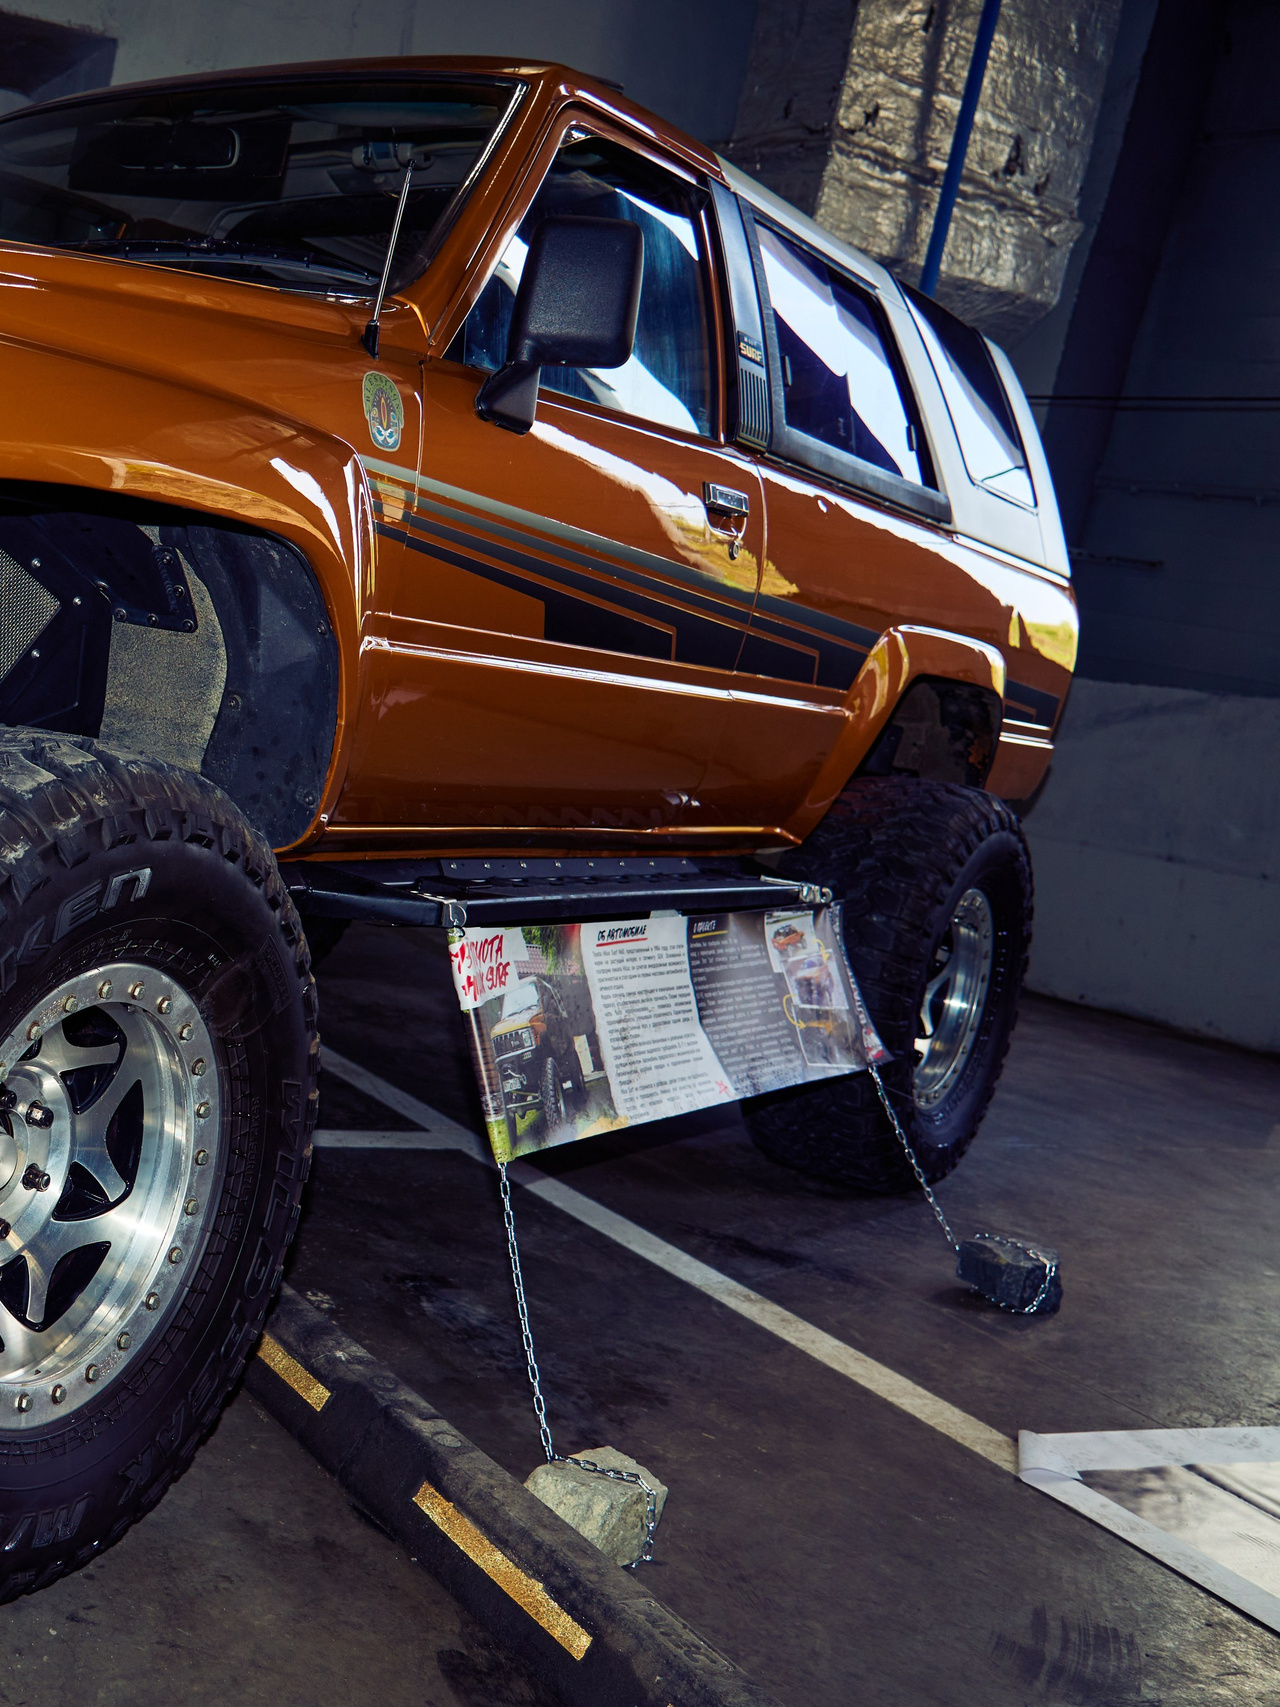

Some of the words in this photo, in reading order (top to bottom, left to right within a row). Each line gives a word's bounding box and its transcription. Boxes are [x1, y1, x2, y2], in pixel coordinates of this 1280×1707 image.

[739, 342, 762, 362] SURF
[597, 930, 606, 941] ОБ
[606, 924, 647, 941] АВТОМОБИЛЕ
[485, 961, 511, 991] SURF
